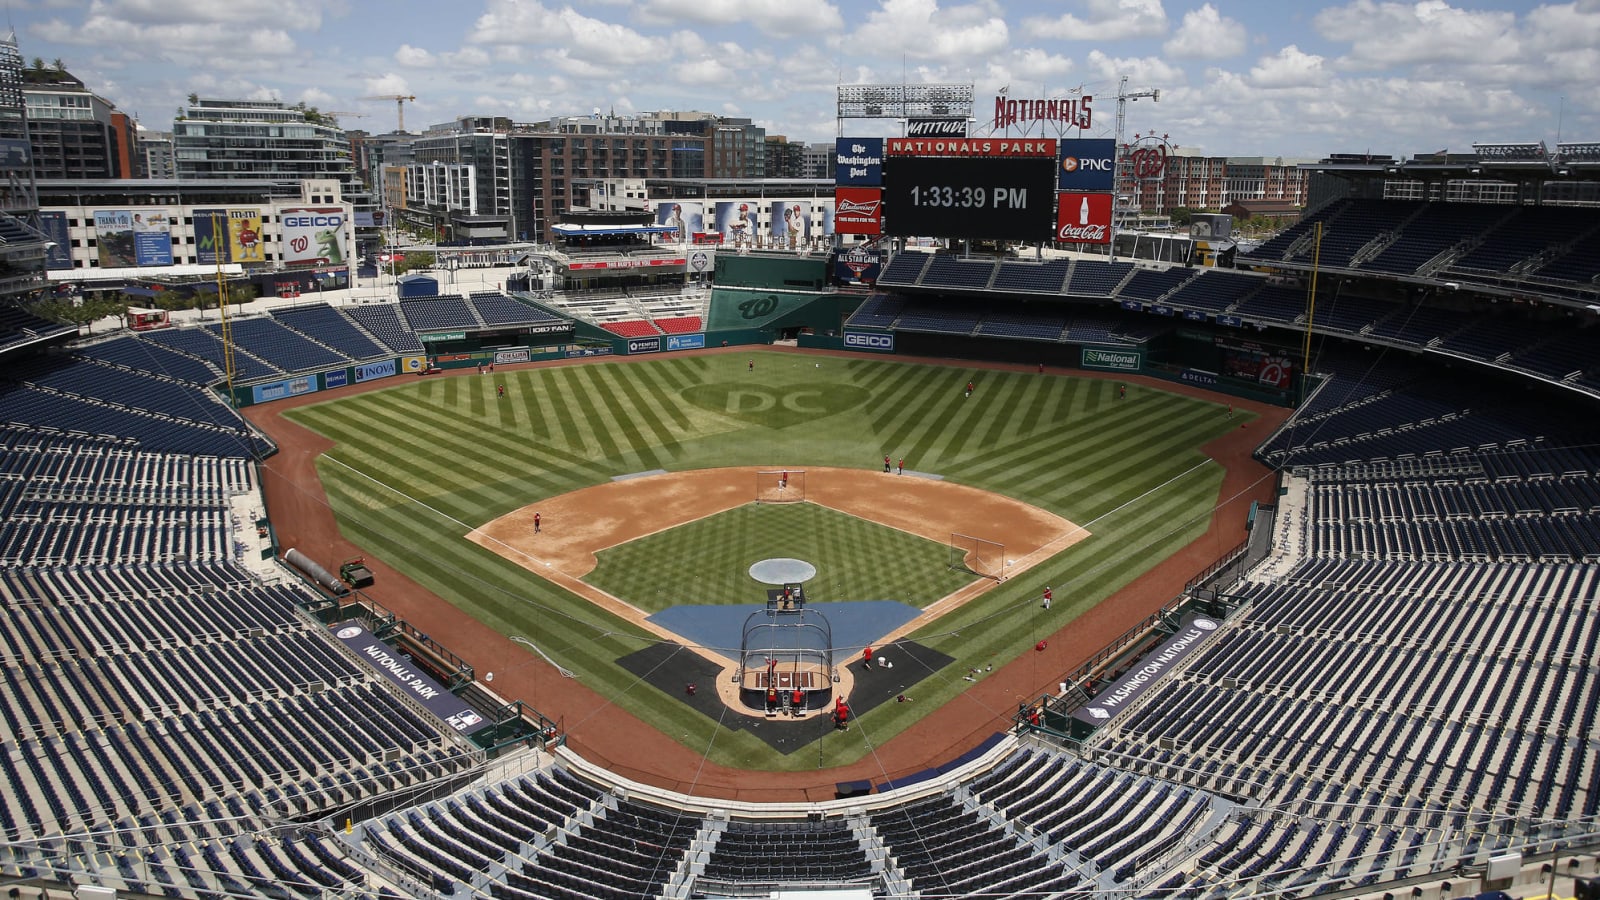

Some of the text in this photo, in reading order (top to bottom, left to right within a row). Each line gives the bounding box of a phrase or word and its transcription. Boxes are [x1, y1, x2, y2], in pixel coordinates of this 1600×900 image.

[994, 96, 1093, 129] NATIONALS
[908, 121, 966, 134] NATITUDE
[852, 144, 866, 153] The
[893, 142, 1046, 153] NATIONALS PARK
[837, 154, 880, 166] Washington
[1080, 159, 1111, 170] PNC
[850, 168, 867, 178] Post
[910, 186, 1027, 209] 1:33:39 PM
[841, 203, 874, 211] Budweiser
[118, 215, 128, 224] YOU
[285, 216, 341, 227] GEICO
[1060, 224, 1107, 240] Coca-Cola
[290, 235, 309, 253] W
[845, 335, 892, 347] GEICO
[1098, 353, 1136, 363] National
[365, 364, 395, 377] INOVA
[1189, 375, 1213, 384] DELTA
[726, 391, 827, 413] DC
[363, 645, 439, 700] NATIONALS PARK
[1102, 629, 1203, 707] WASHINGTON NATIONALS
[445, 715, 467, 731] MLB
